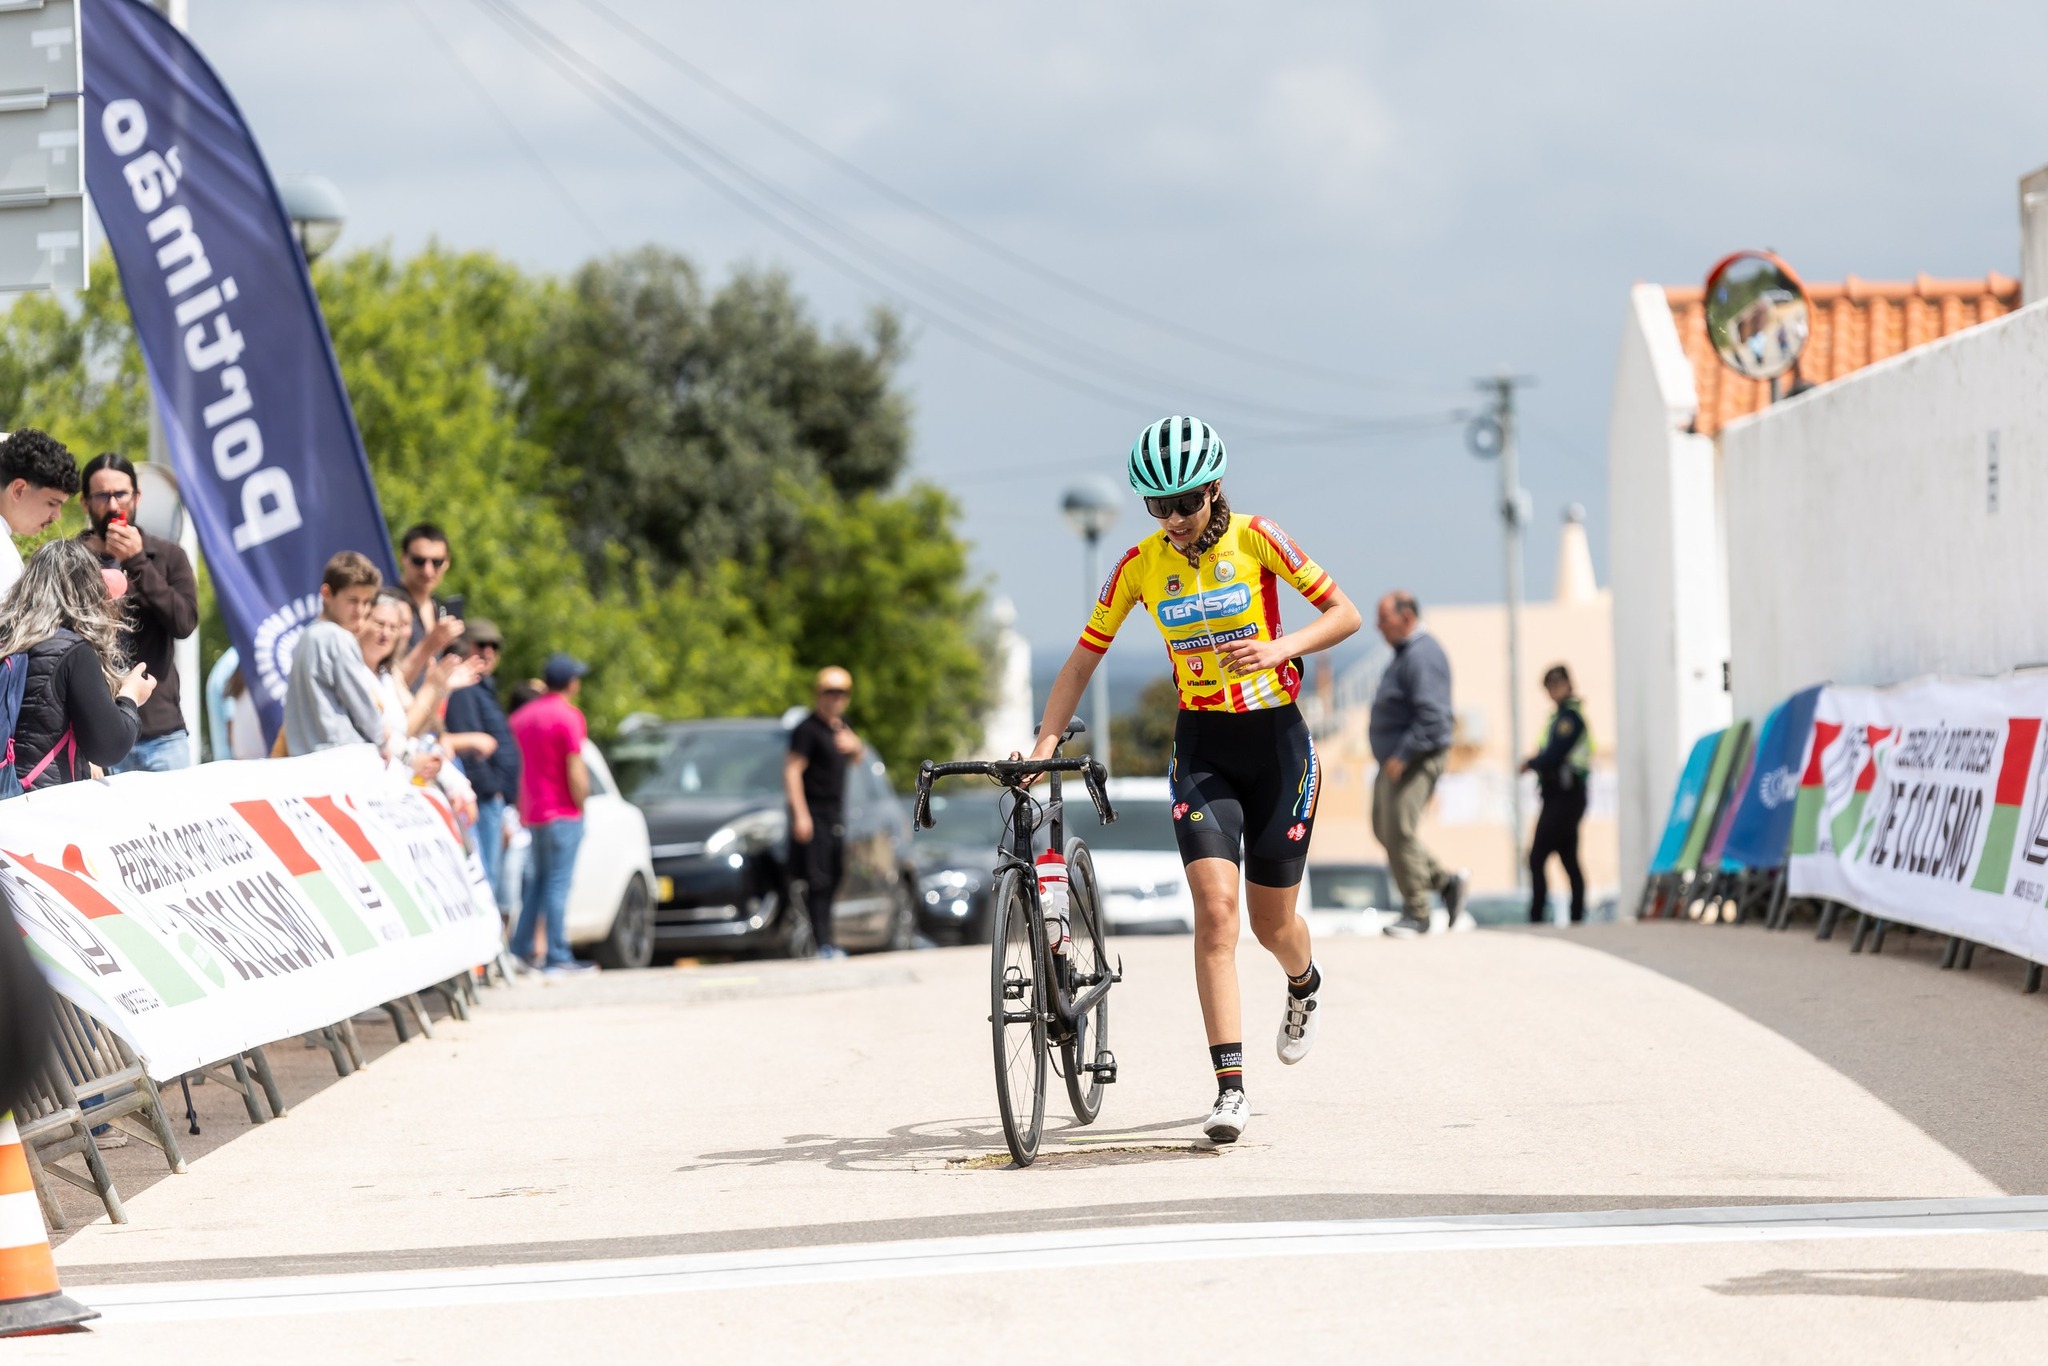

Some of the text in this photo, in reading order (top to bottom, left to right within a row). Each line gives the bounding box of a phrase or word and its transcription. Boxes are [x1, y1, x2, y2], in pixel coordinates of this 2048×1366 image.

[1259, 519, 1303, 568] sambiental
[1161, 588, 1248, 620] TENSAI
[1172, 623, 1257, 651] sambiental
